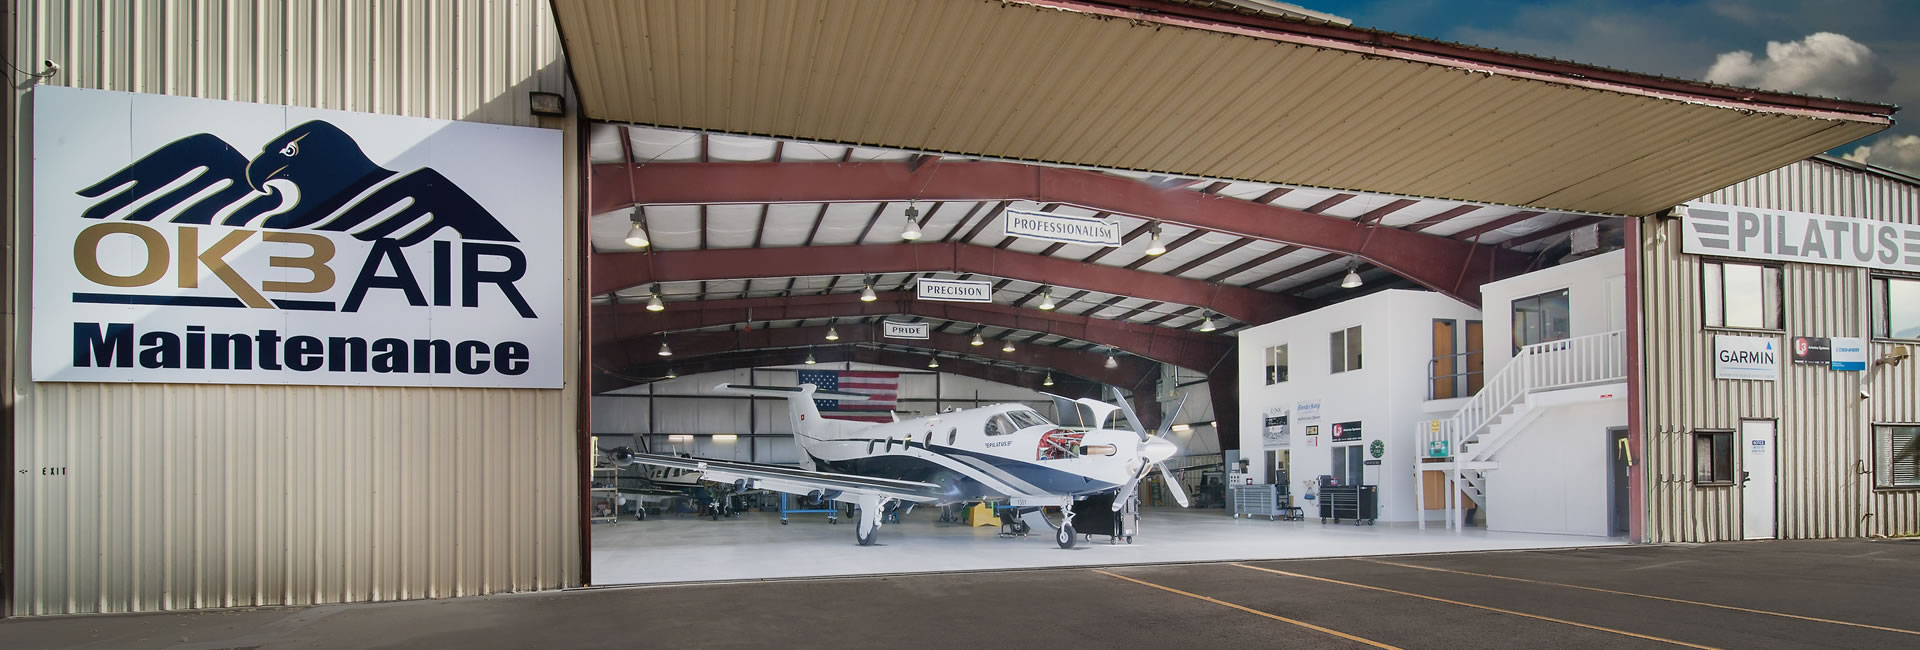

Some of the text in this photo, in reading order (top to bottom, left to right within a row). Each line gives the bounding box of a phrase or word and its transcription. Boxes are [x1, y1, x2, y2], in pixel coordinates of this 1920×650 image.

[1014, 217, 1112, 239] PROFESSIONALISM
[1737, 211, 1899, 265] PILATUS
[340, 237, 538, 319] AIR
[927, 285, 982, 296] PRECISION
[892, 326, 921, 335] PRIDE
[73, 322, 530, 376] Maintenance
[1719, 349, 1774, 365] GARMIN
[42, 467, 66, 476] EXIT
